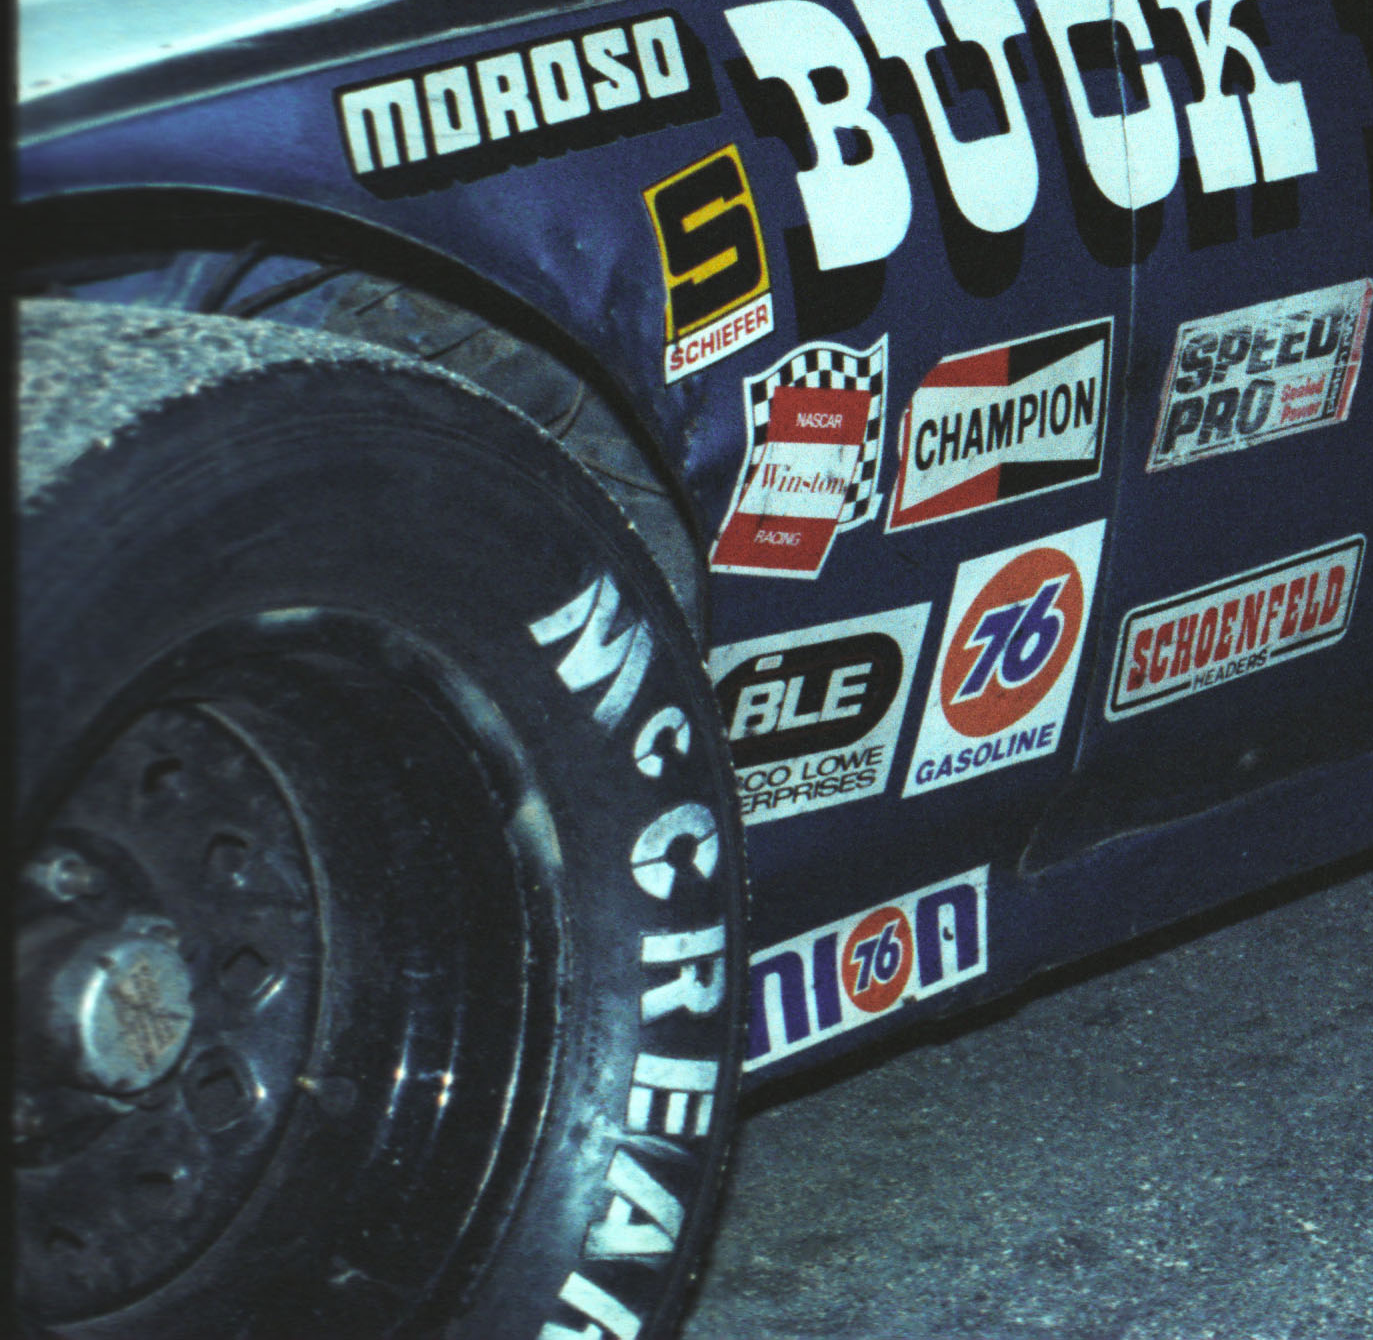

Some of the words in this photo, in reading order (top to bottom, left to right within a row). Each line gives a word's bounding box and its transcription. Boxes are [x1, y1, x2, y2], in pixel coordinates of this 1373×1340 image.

[340, 16, 691, 174] MOROSO
[653, 155, 763, 331] S
[670, 304, 769, 372] SCHIEFER
[1175, 308, 1344, 394] SPEED
[796, 413, 843, 429] NASCAR
[915, 377, 1096, 471] CHAMPION
[1160, 378, 1276, 455] PRO
[761, 463, 846, 494] Winston
[754, 530, 802, 546] RACING
[950, 573, 1072, 706] 76
[1127, 565, 1345, 692] SCHOENFELD
[1192, 648, 1270, 690] HEADERS
[802, 745, 886, 780] LOWE
[914, 722, 1057, 786] GASOLINE
[850, 917, 903, 997] 76
